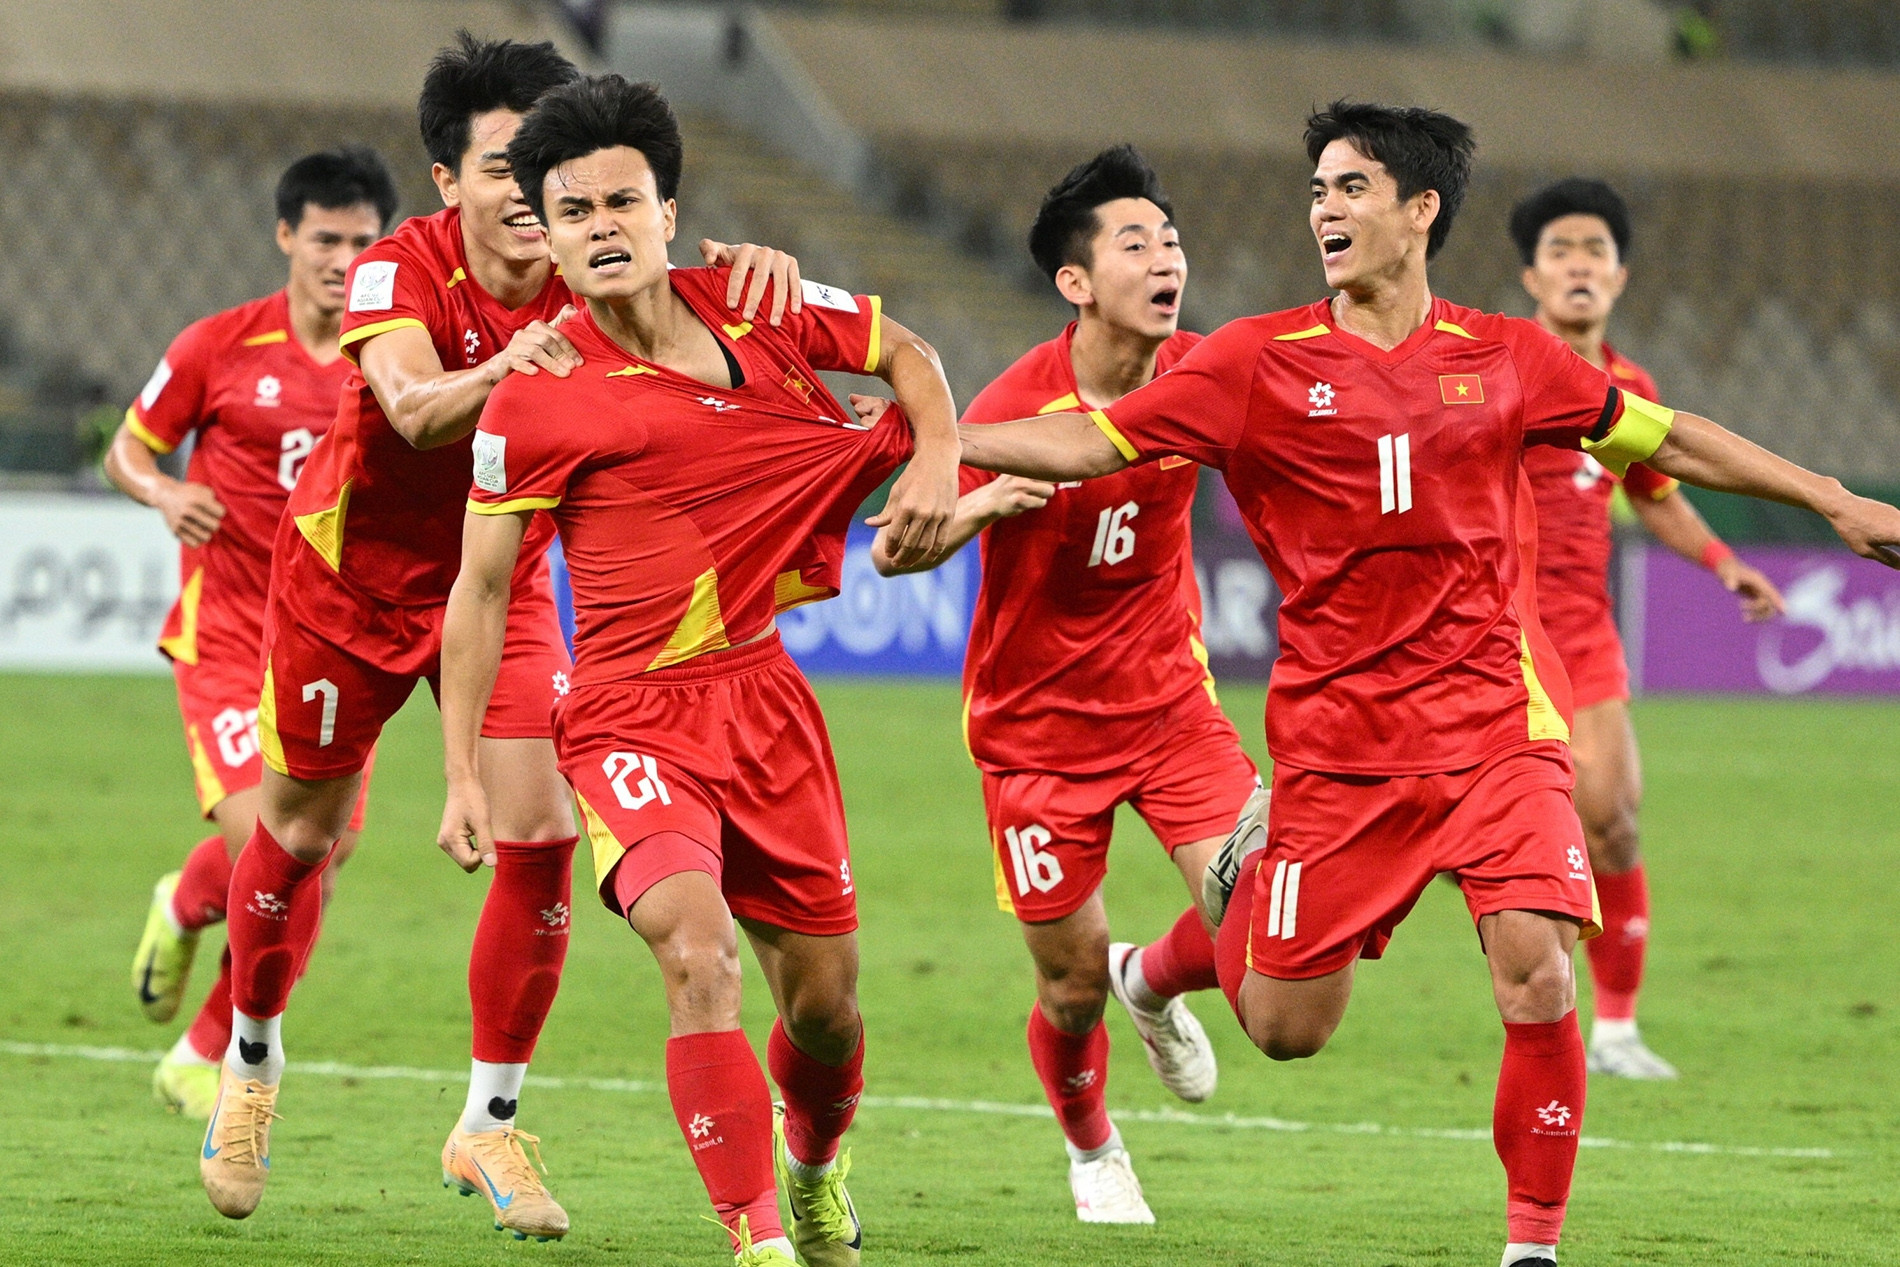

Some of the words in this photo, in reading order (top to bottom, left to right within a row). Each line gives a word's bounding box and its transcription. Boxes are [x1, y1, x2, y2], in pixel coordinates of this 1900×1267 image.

[278, 427, 327, 492] 2
[1377, 432, 1413, 515] 11
[1088, 500, 1139, 567] 16
[302, 678, 339, 748] 7
[601, 751, 672, 811] 21
[1004, 823, 1064, 897] 16
[1267, 859, 1303, 940] 11
